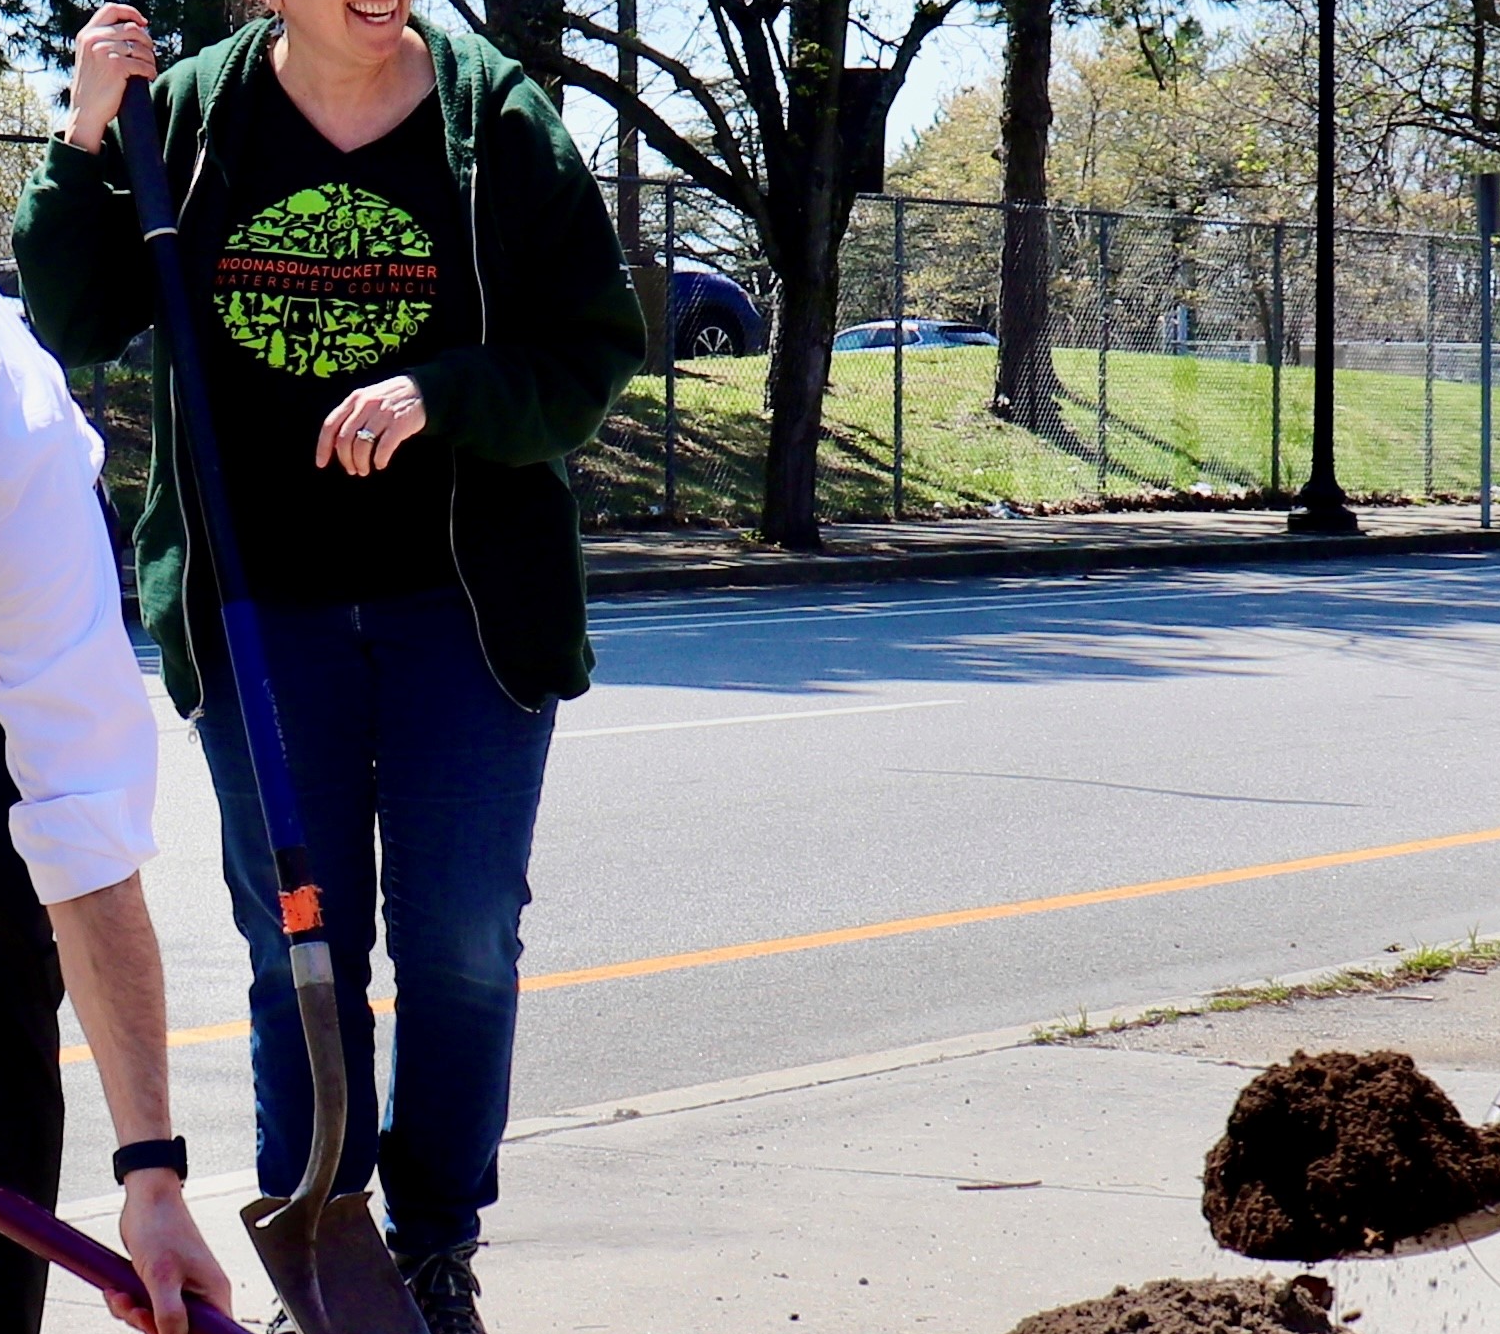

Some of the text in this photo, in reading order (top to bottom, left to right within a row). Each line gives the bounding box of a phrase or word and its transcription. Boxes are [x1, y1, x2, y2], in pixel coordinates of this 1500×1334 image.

[217, 257, 438, 279] WOONASQUATUCKET RIVER
[215, 274, 437, 295] WATERSHED COUNCIL
